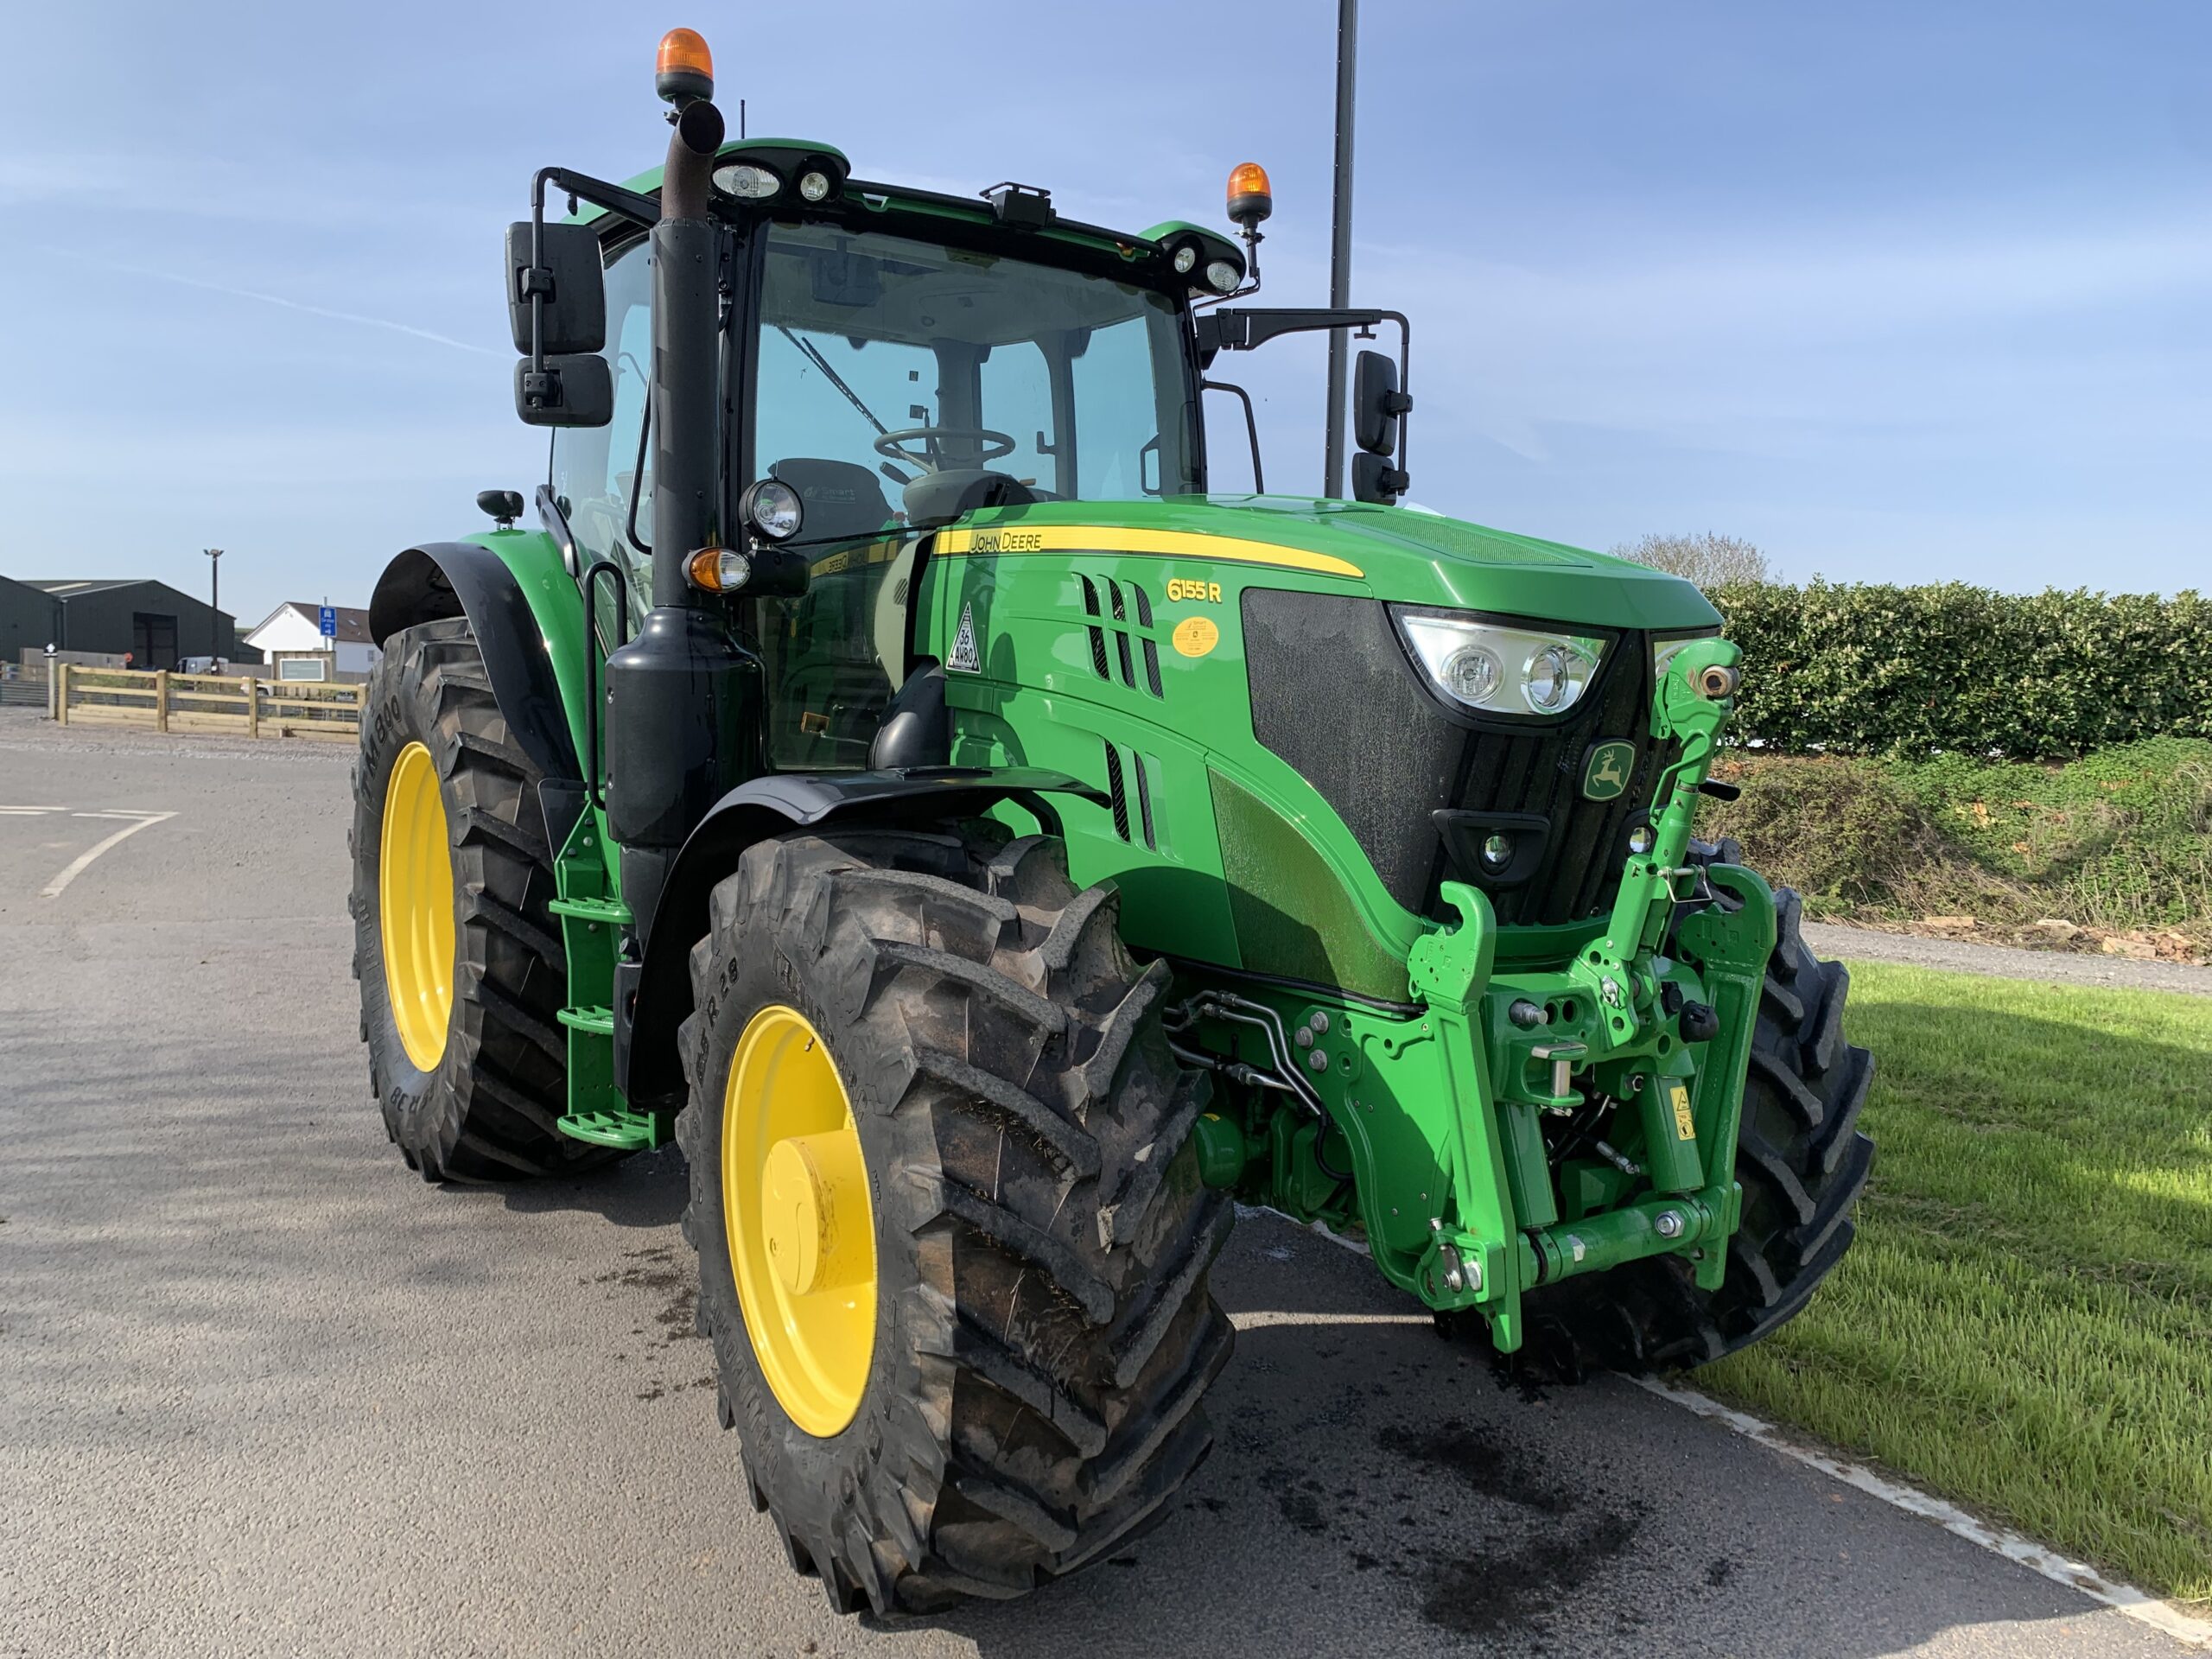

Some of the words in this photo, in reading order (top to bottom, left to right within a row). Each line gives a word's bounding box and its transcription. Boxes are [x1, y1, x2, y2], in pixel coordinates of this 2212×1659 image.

[970, 533, 1001, 551] JOHN
[1002, 532, 1042, 550] DEERE
[1166, 578, 1206, 603] 6155
[1208, 582, 1223, 604] R
[960, 629, 969, 645] 36
[719, 957, 739, 1002] 28
